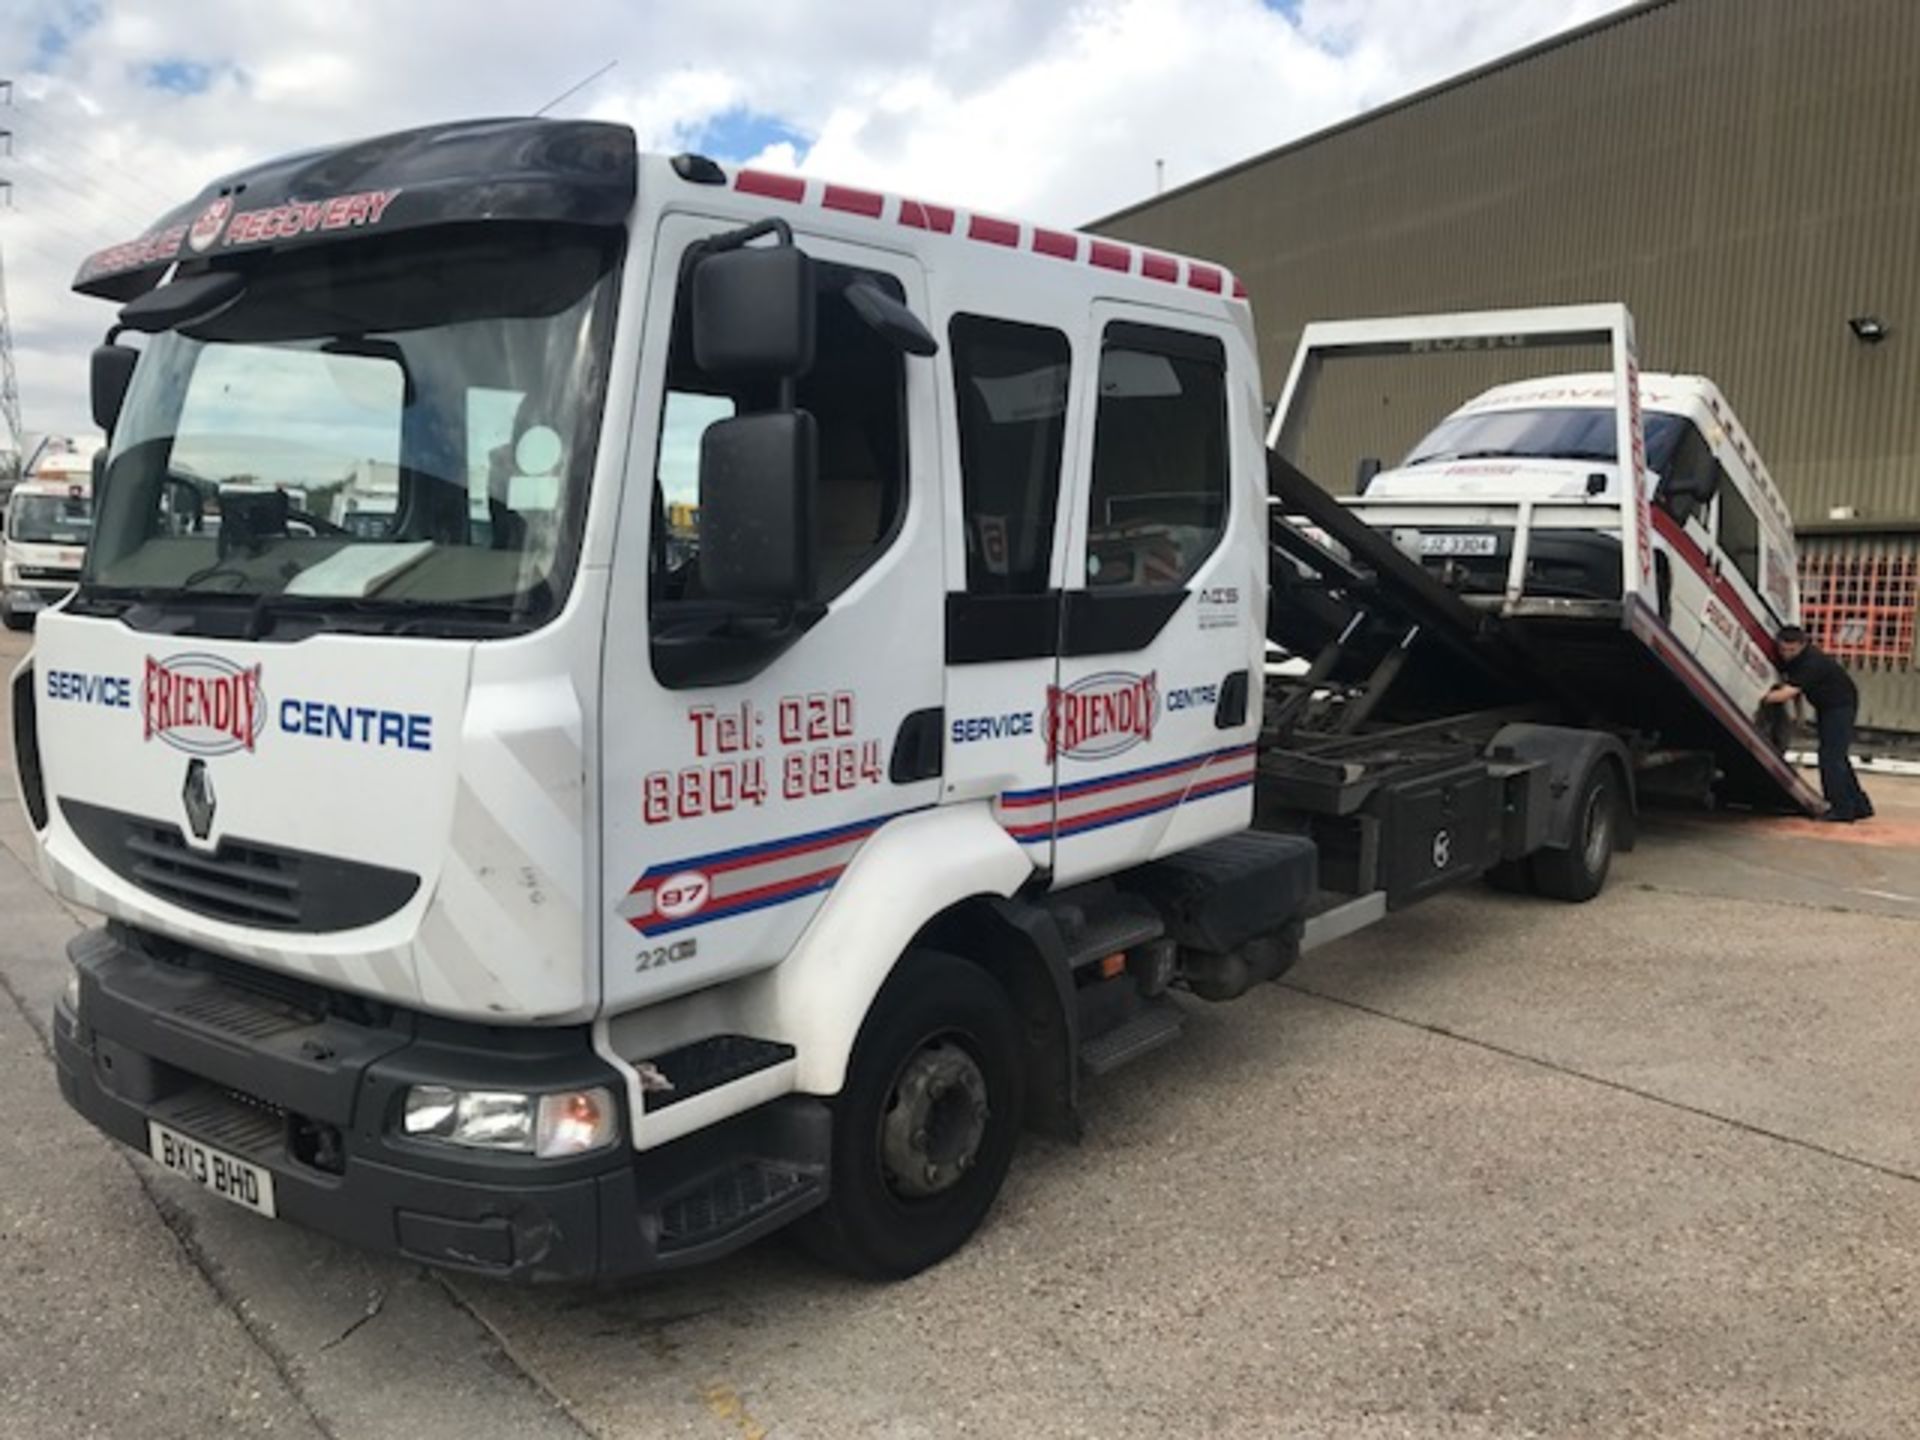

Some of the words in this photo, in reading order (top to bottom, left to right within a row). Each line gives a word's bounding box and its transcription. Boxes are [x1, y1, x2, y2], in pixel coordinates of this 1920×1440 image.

[222, 188, 402, 246] RECOVERY
[47, 670, 130, 708] SERVICE
[143, 654, 262, 754] FRIENDLY
[279, 698, 432, 751] CENTRE
[688, 705, 763, 757] Tel:
[779, 690, 855, 744] 020
[951, 712, 1034, 744] SERVICE
[1046, 669, 1156, 766] FRIENDLY
[1167, 683, 1217, 711] CENTRE
[661, 884, 704, 907] 97
[161, 1131, 208, 1184] BX13
[212, 1154, 259, 1206] BHD
